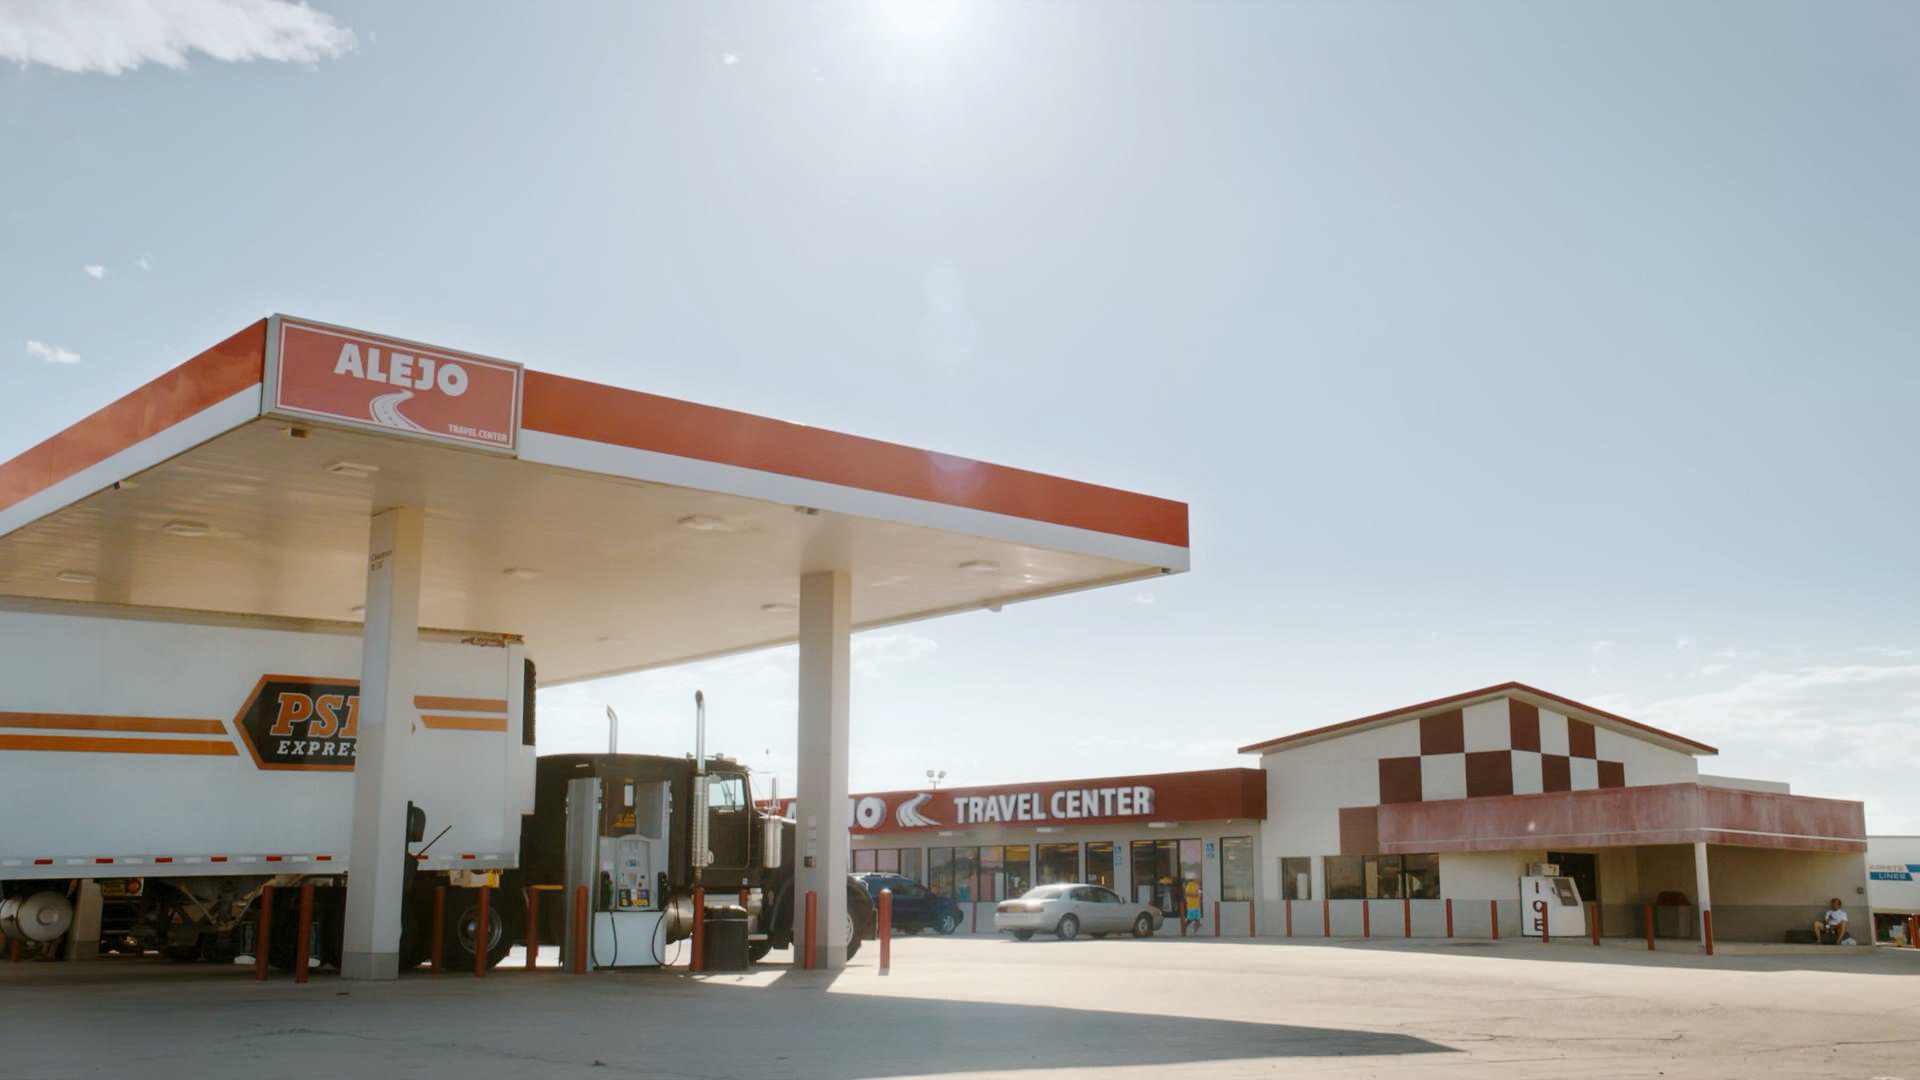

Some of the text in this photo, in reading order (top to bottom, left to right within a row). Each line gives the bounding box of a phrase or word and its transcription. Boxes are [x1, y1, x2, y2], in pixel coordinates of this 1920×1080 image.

[334, 342, 469, 397] ALEJO
[448, 423, 508, 441] TRAVEL CENTER
[953, 792, 1046, 824] TRAVEL
[1050, 785, 1155, 819] CENTER
